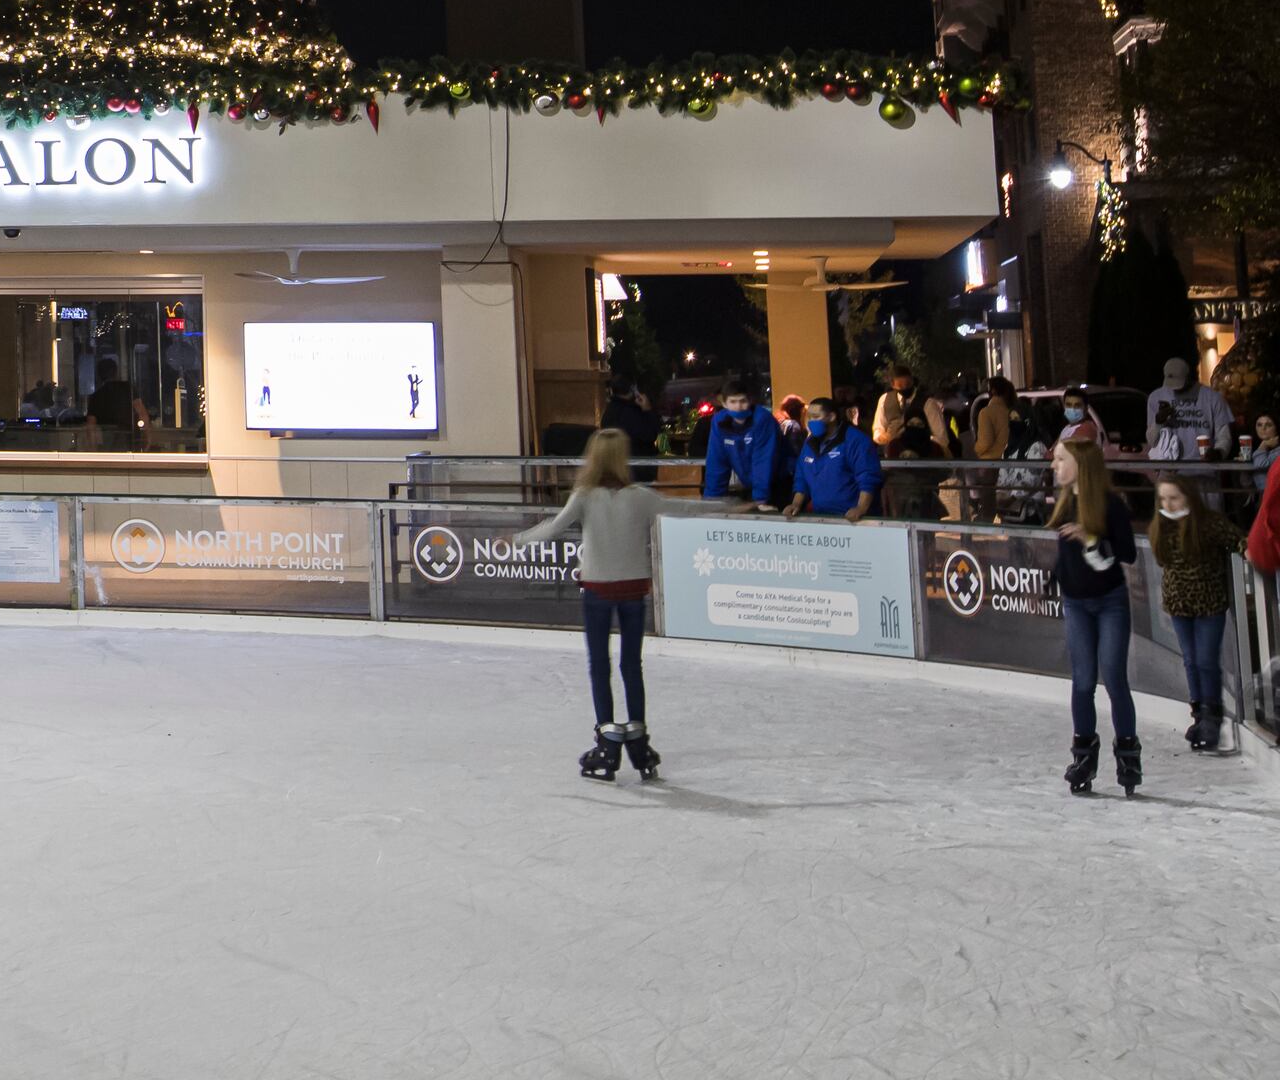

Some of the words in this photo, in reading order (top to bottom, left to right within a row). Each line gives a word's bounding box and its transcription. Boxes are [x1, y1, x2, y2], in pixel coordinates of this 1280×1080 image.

[175, 529, 262, 553] NORTH
[270, 532, 344, 554] POINT
[706, 530, 735, 543] LET'S
[736, 531, 772, 545] BREAK
[774, 533, 795, 545] THE
[797, 535, 814, 546] ICE
[816, 536, 851, 549] ABOUT
[473, 538, 557, 564] NORTH
[175, 553, 273, 569] COMMUNITY
[278, 556, 344, 570] CHURCH
[717, 552, 819, 581] coolsculpting
[286, 573, 344, 584] northpoint.org
[474, 563, 568, 582] COMMUNITY
[990, 564, 1054, 595] NORTH
[735, 590, 755, 599] Come
[778, 594, 803, 602] Medical
[804, 595, 815, 605] Spa
[816, 596, 826, 604] for
[992, 594, 1060, 616] COMMUNITY
[713, 601, 763, 612] complimentary
[764, 604, 804, 614] consultation
[830, 609, 842, 619] you
[742, 613, 775, 622] candidate
[776, 614, 785, 623] for
[880, 595, 901, 639] AYA
